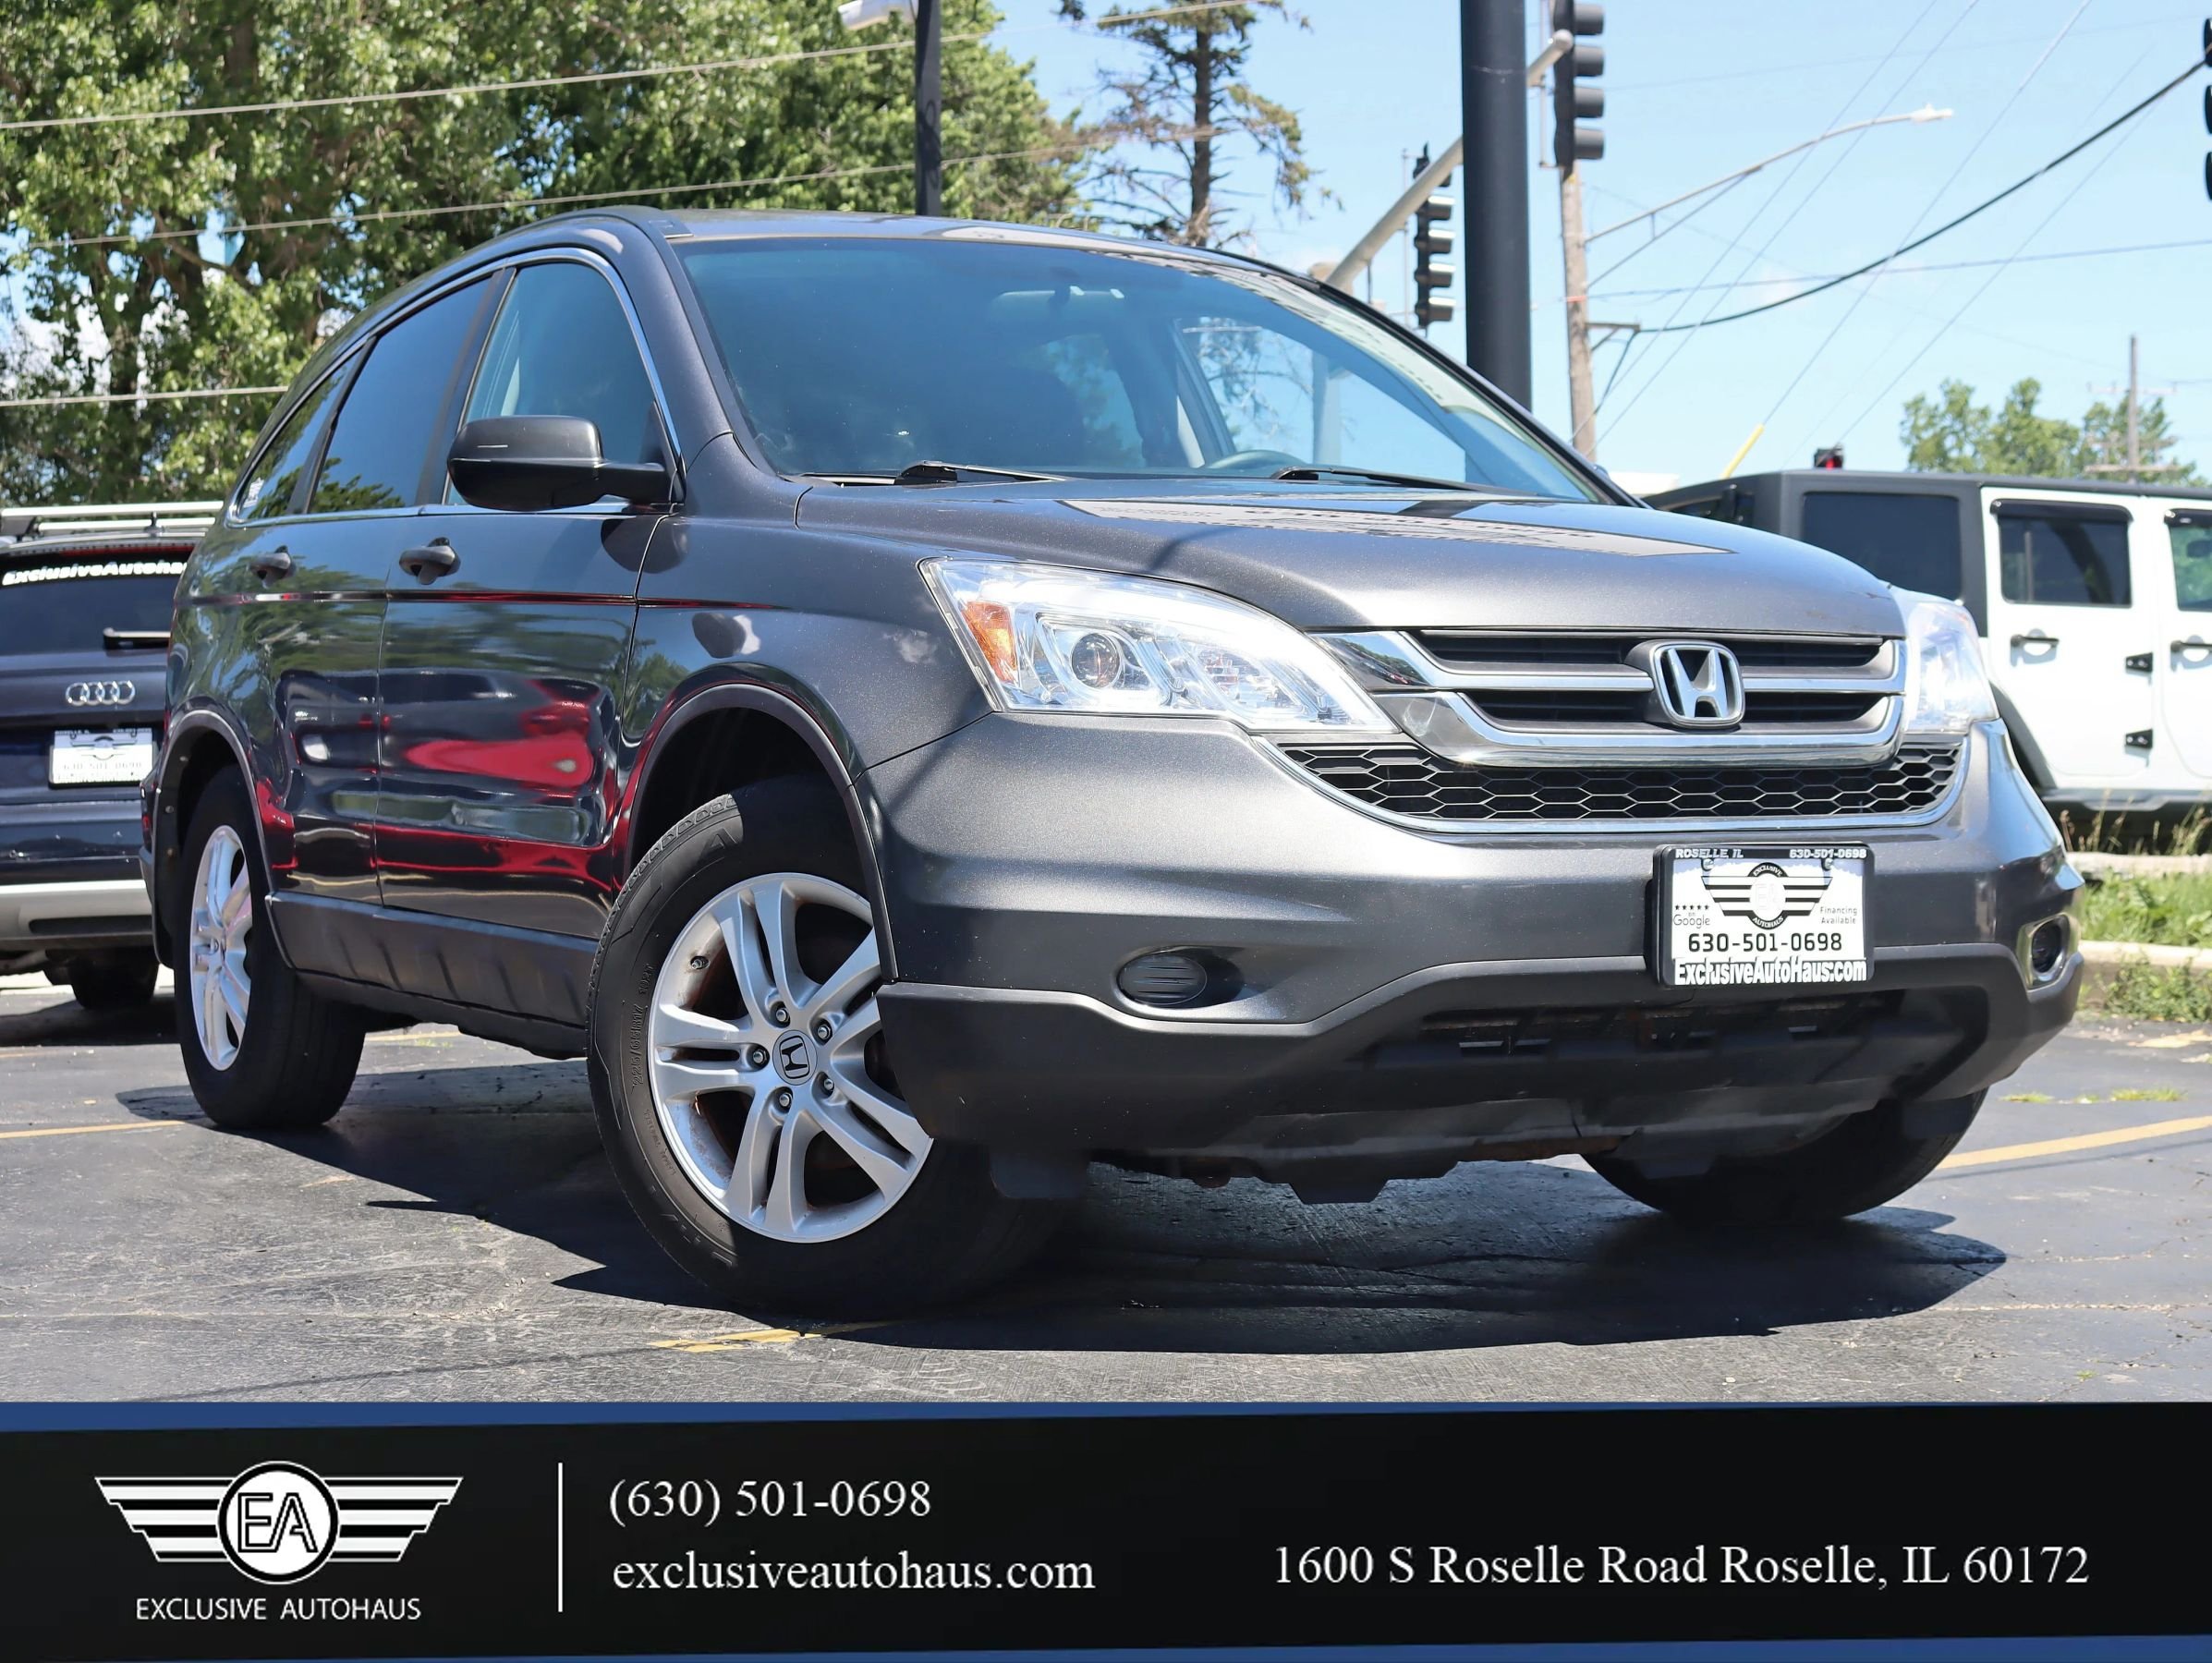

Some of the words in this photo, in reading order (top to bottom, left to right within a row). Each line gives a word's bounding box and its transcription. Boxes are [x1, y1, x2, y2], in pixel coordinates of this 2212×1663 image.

[2, 559, 188, 586] ExclusiveAutoha
[1732, 849, 1744, 858] IL
[1789, 848, 1867, 859] 630-501-0698
[1753, 865, 1783, 877] EXCLUSIVE
[1819, 905, 1857, 916] Financing
[1673, 914, 1710, 929] Google
[1752, 916, 1784, 929] AUTOHAUS
[1821, 916, 1856, 925] Available
[1688, 932, 1842, 953] 630-501-0698
[1674, 955, 1868, 986] ExclusiveAutoHaus.com
